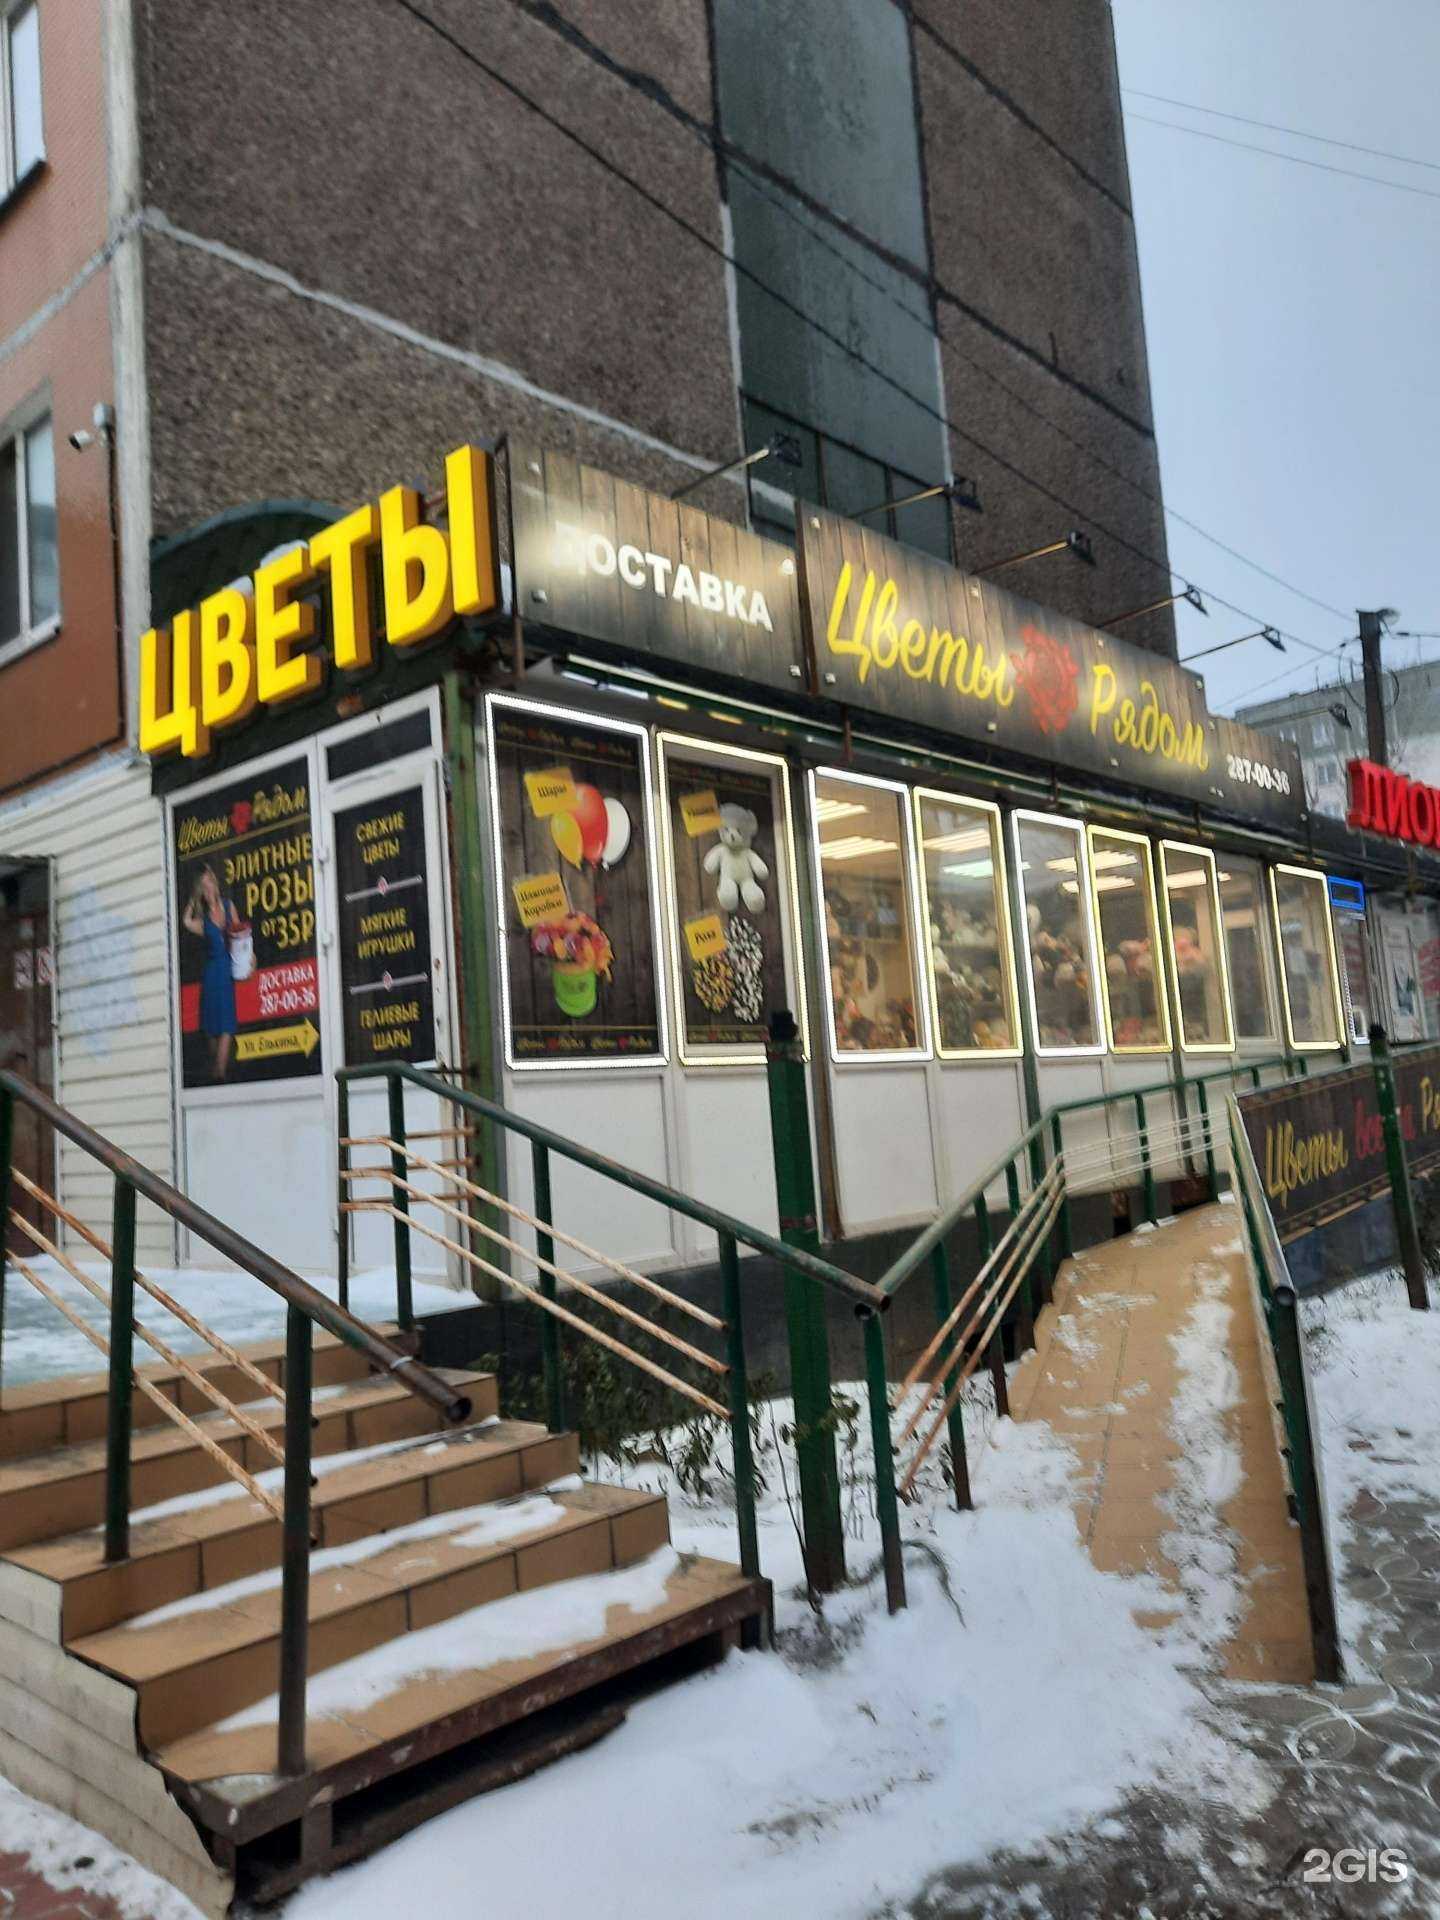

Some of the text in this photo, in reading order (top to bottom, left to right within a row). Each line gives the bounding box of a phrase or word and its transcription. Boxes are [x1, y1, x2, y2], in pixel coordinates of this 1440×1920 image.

[555, 520, 774, 633] ДОСТАВКА
[140, 443, 494, 757] ЦВЕТЫ
[826, 560, 1209, 771] Цветы Рядом
[356, 811, 406, 842] СВЕЖИЕ
[224, 832, 313, 885] ЭЛИТНЫЕ
[362, 839, 400, 865] ЦВЕТЫ
[246, 864, 314, 919] РОЗЫ
[360, 908, 408, 935] МЯГКИЕ
[357, 931, 416, 960] ИГРУШКИ
[259, 963, 316, 993] ДОСТАВКА
[372, 1019, 412, 1051] ШАРЫ
[1266, 1120, 1349, 1209] Цветы
